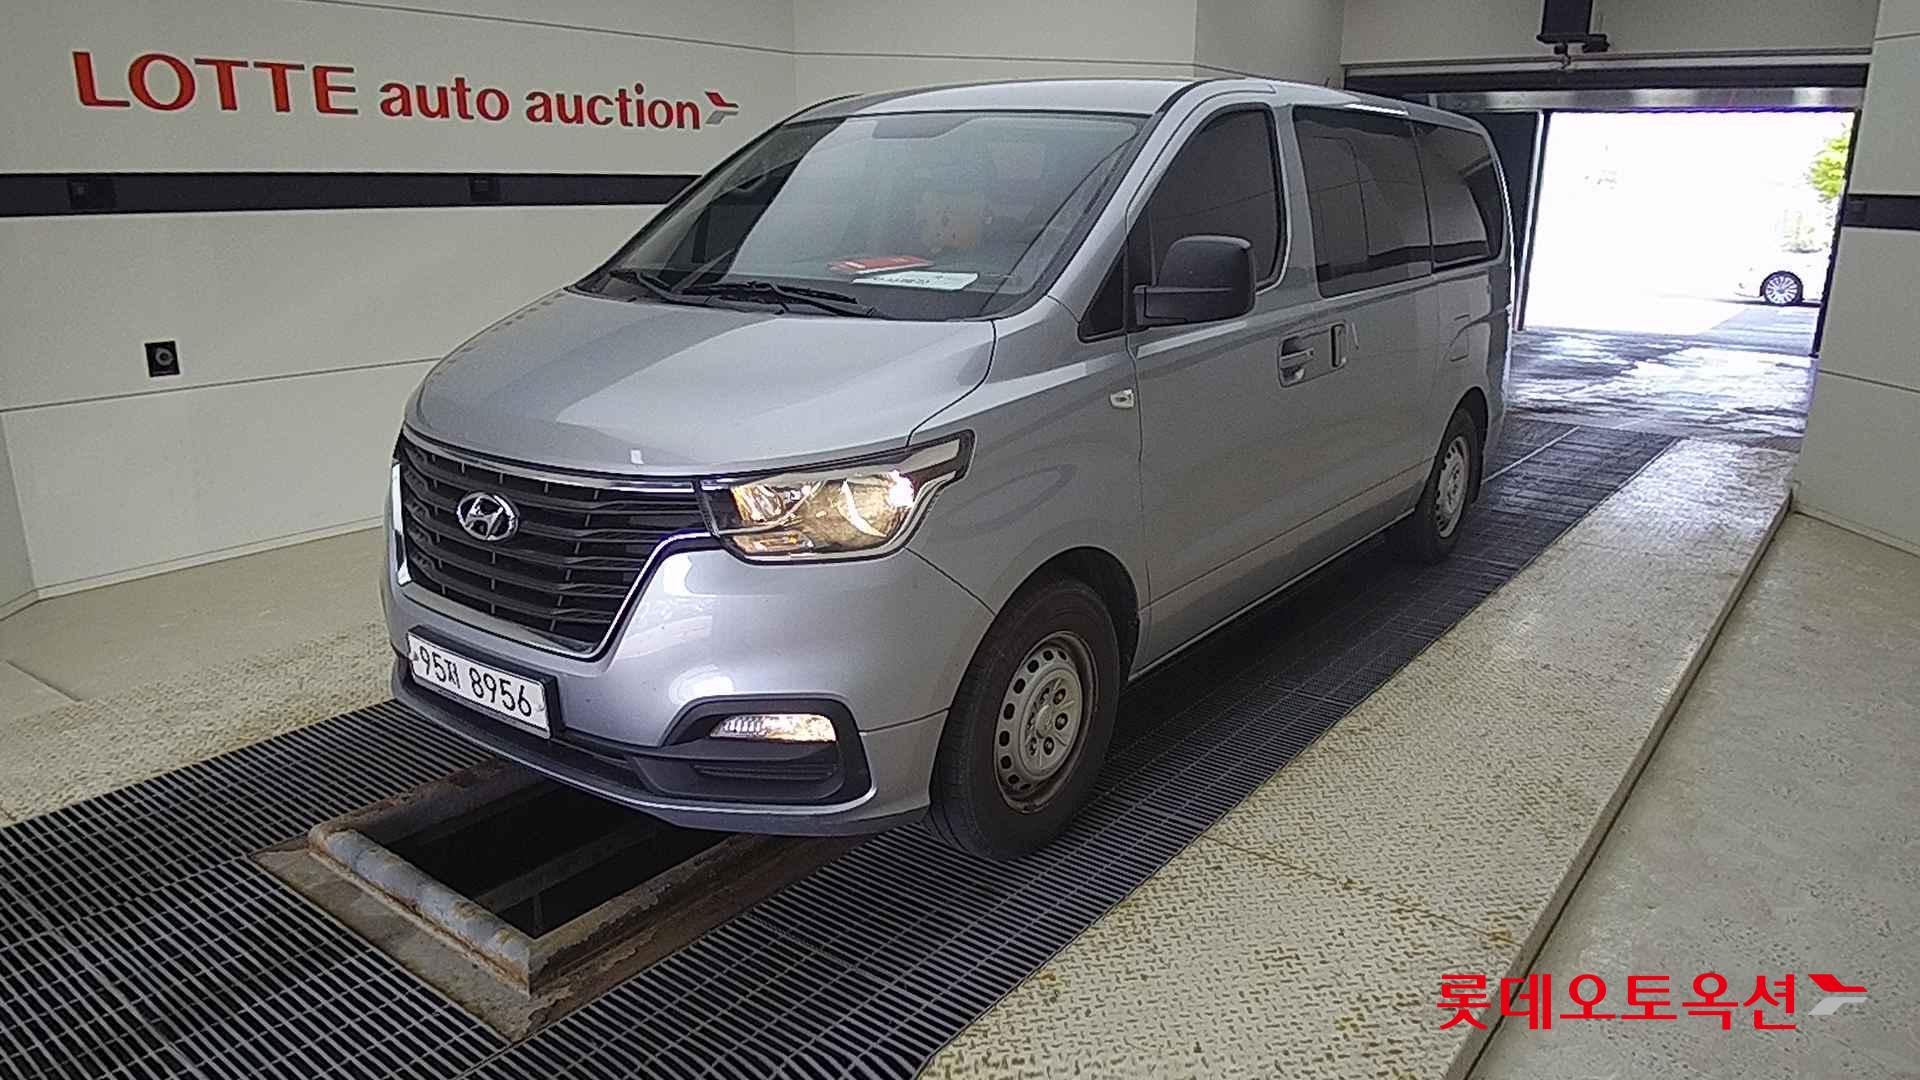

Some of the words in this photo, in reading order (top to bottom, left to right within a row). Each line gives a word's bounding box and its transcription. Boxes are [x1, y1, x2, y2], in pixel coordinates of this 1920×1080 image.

[73, 51, 359, 115] LOTTE
[380, 77, 510, 122] auto
[526, 83, 701, 130] auction
[419, 645, 461, 690] 95저
[469, 667, 532, 717] 8956
